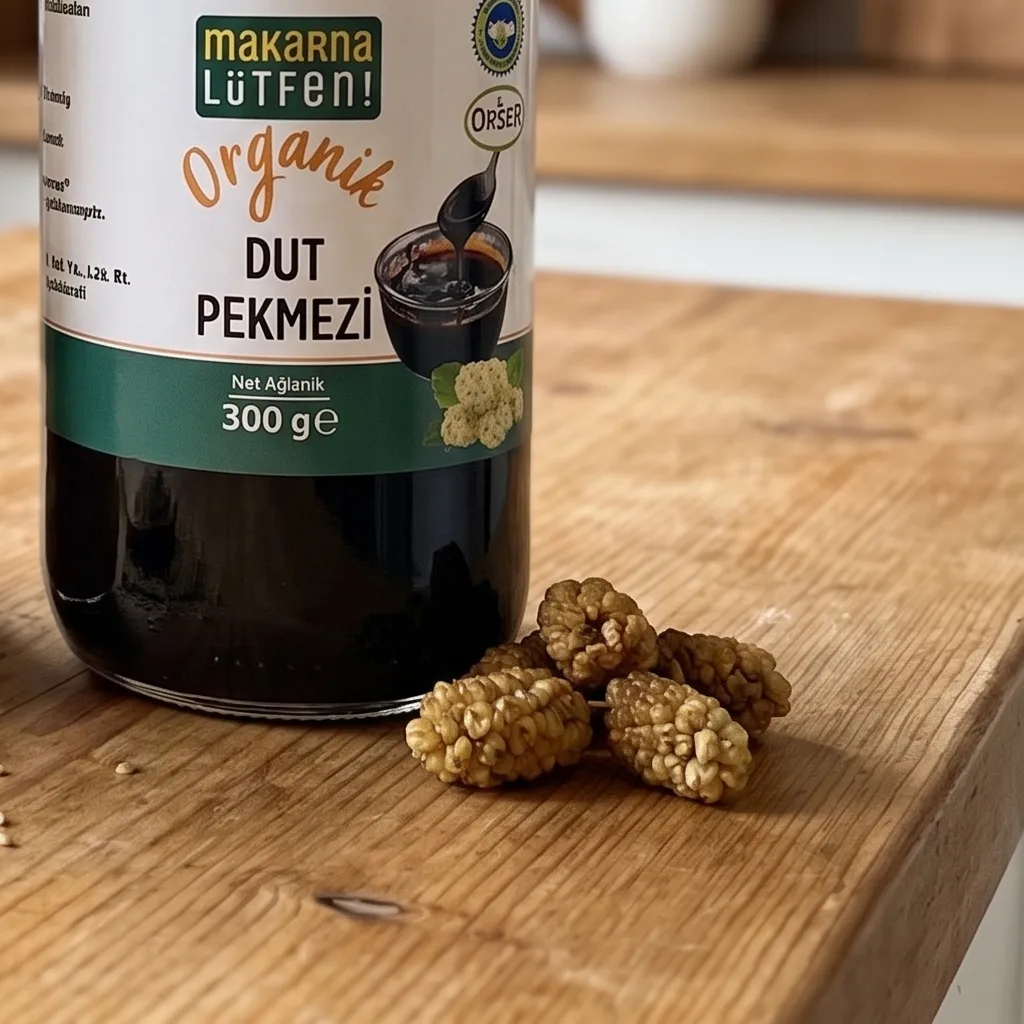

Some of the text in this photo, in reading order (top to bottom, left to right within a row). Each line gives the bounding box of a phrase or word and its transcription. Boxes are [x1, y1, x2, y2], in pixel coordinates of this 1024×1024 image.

[182, 125, 394, 223] Organik
[246, 237, 324, 281] DUT
[197, 286, 372, 341] PEKMEZİ
[232, 375, 260, 390] Net
[222, 403, 283, 433] 300
